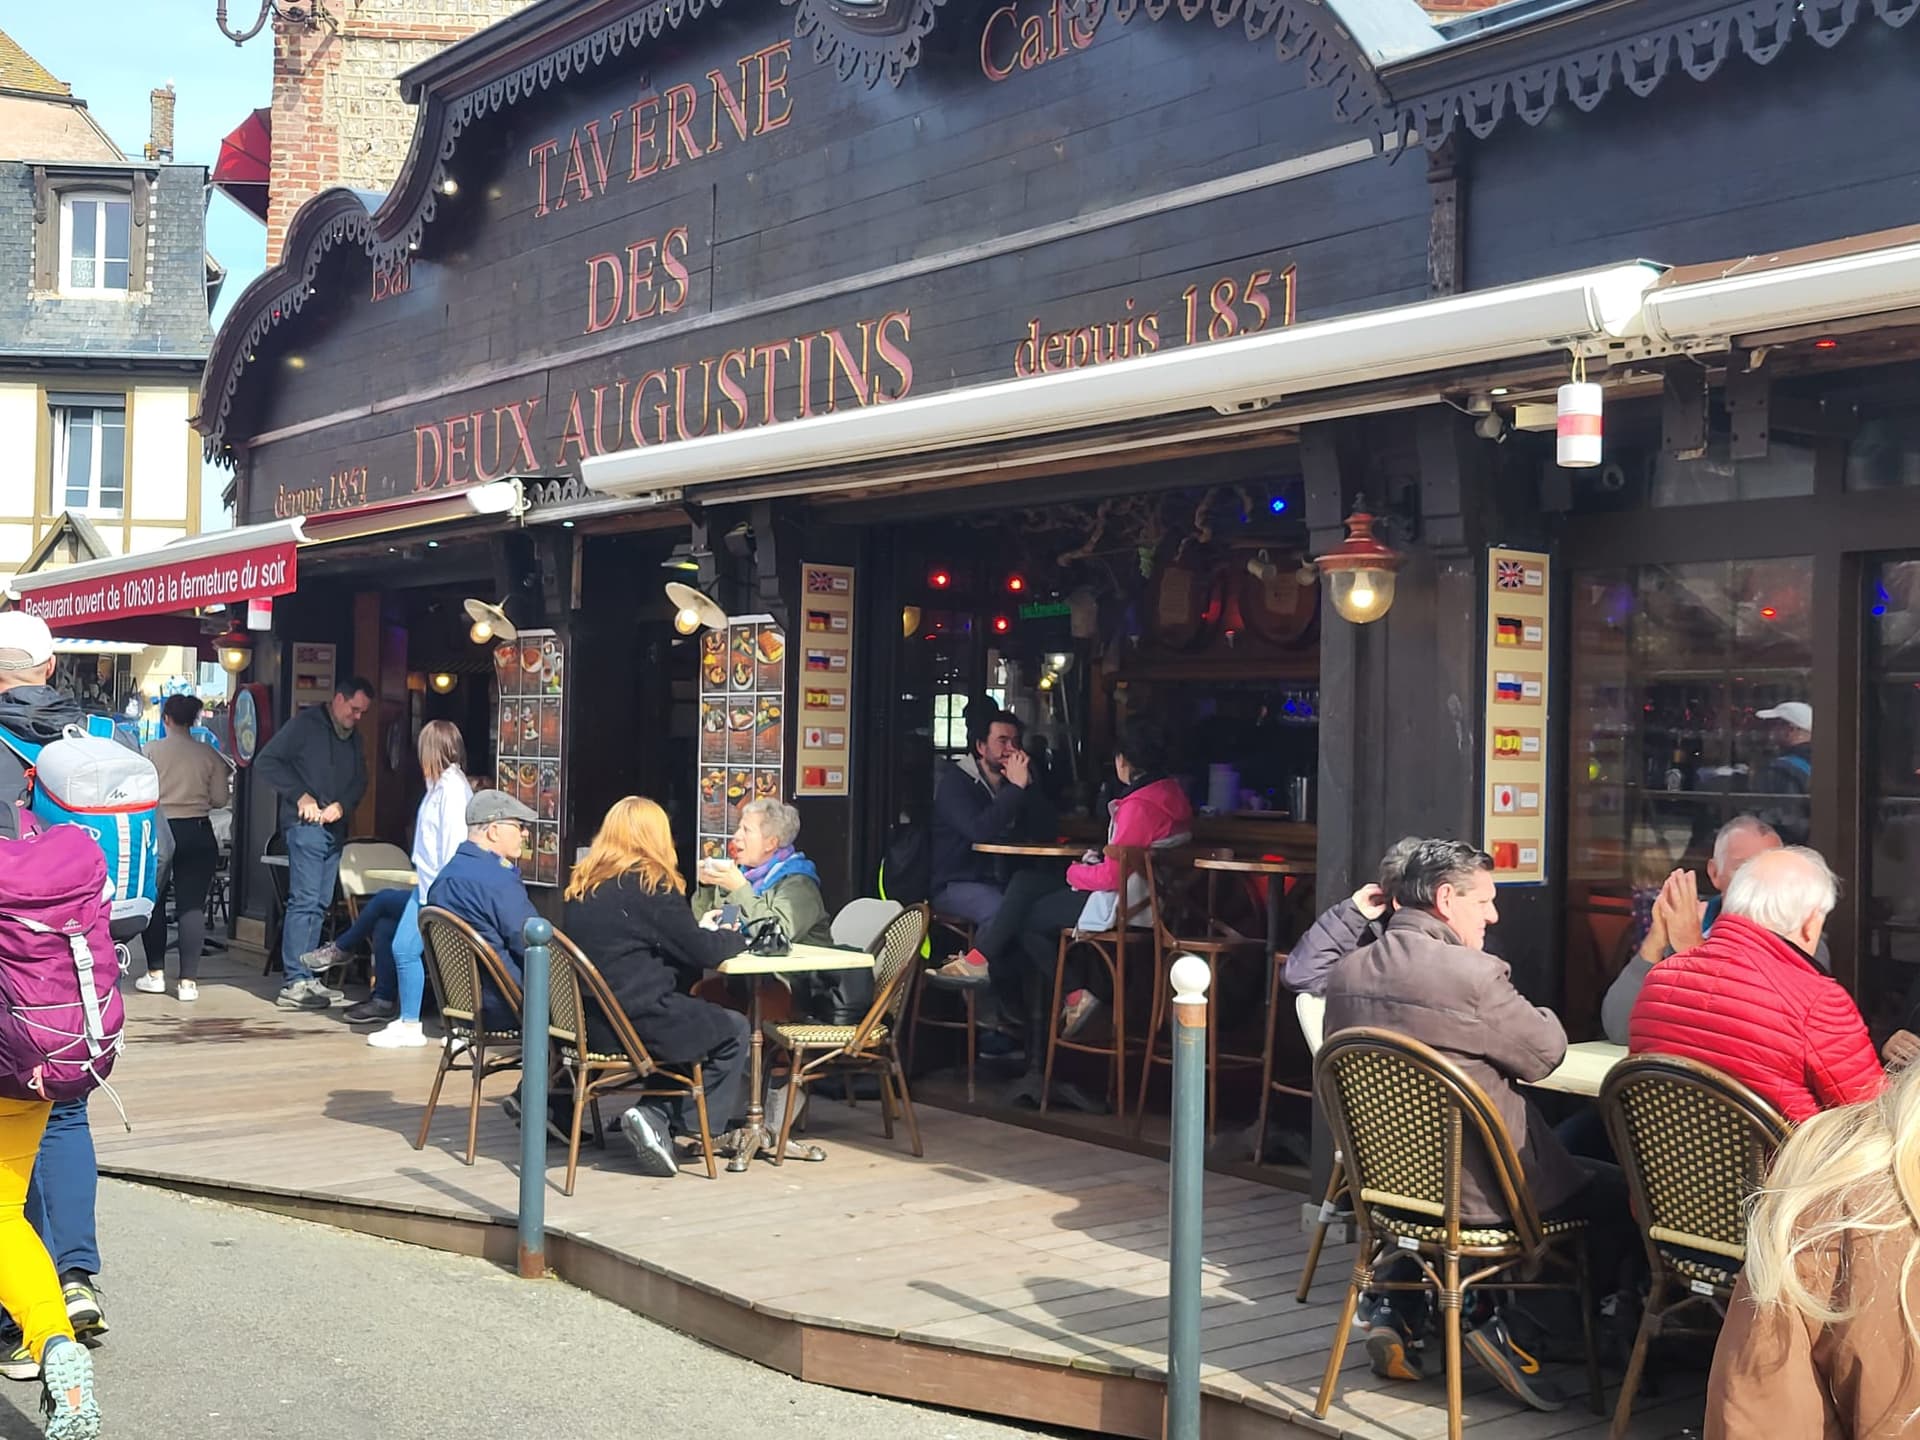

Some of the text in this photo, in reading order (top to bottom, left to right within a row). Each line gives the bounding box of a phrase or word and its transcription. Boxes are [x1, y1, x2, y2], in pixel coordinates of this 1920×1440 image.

[528, 39, 793, 218] TAVERNE
[584, 224, 689, 334] DES
[1014, 262, 1297, 378] depuis 1851
[411, 307, 914, 494] DEUX AUGUSTINS
[328, 464, 368, 510] 1851
[25, 553, 286, 620] Restaurant ouvert de 10h30 à la fermeture du soir
